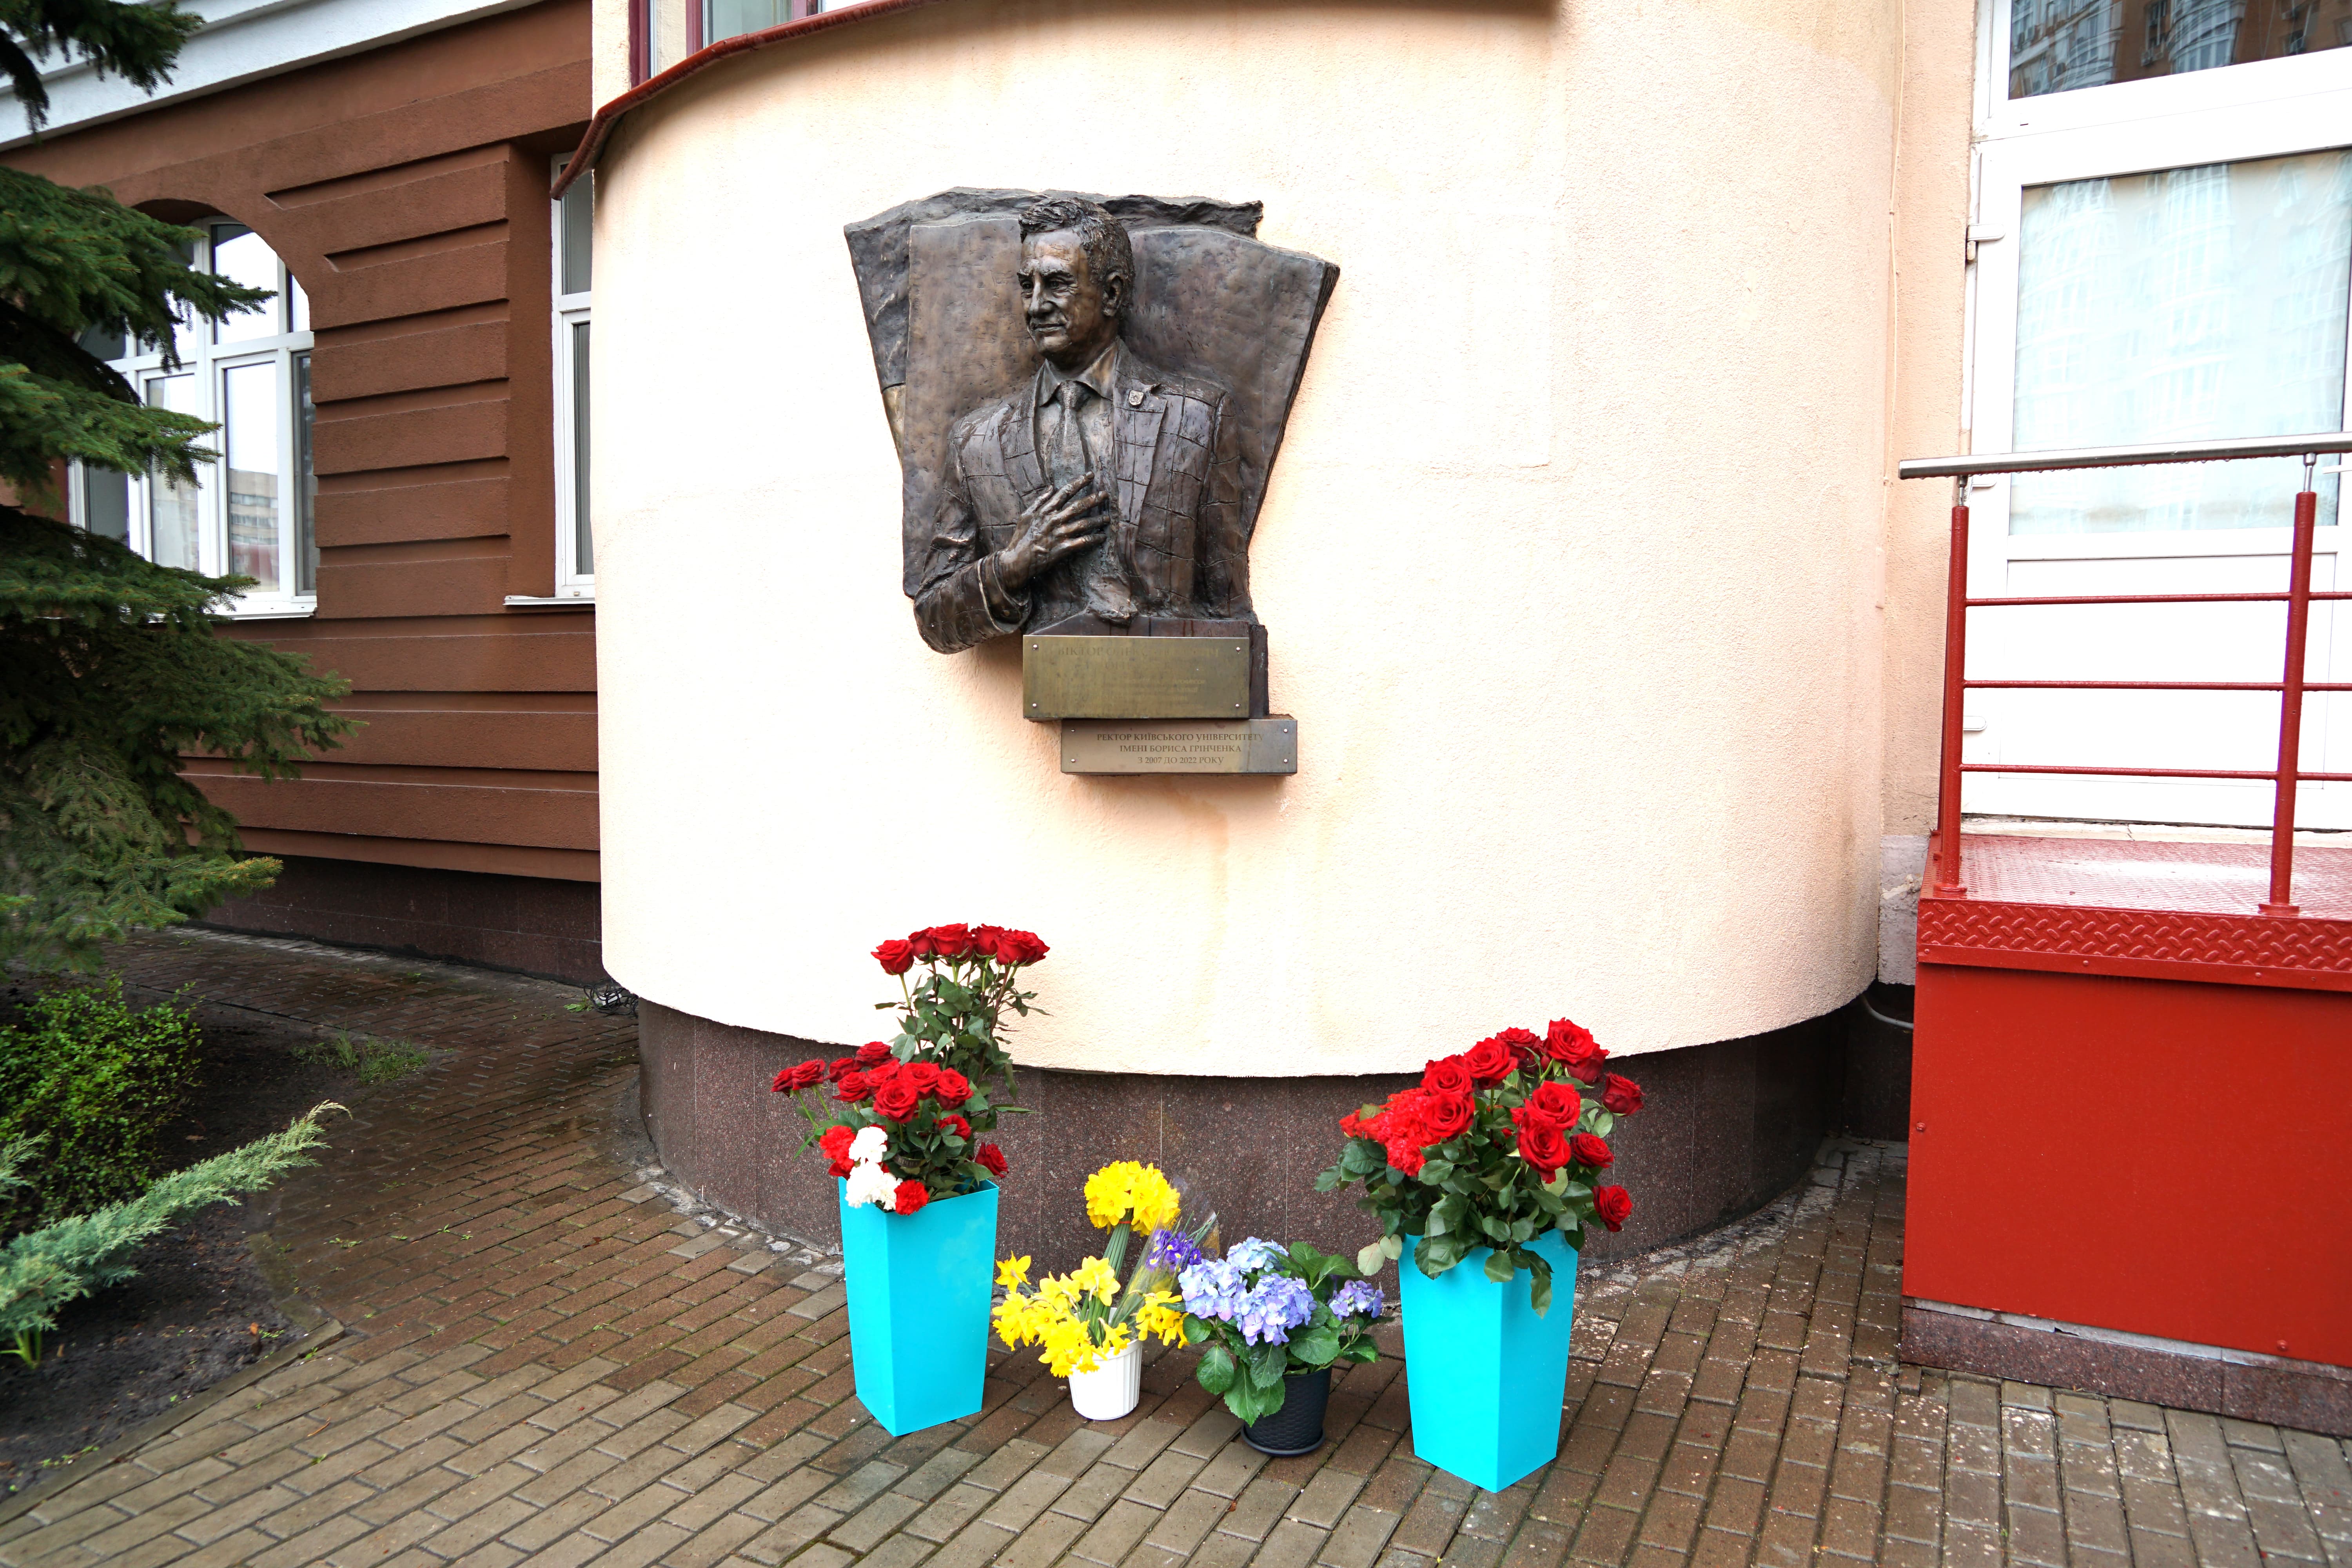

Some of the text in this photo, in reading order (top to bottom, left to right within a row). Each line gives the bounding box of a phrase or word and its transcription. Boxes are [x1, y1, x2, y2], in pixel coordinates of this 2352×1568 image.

[1134, 732, 1194, 741] КИЇВСЬКОГО
[1196, 733, 1264, 742] УНІВЕРСИТЕТУ
[1199, 757, 1224, 765] РОКУ
